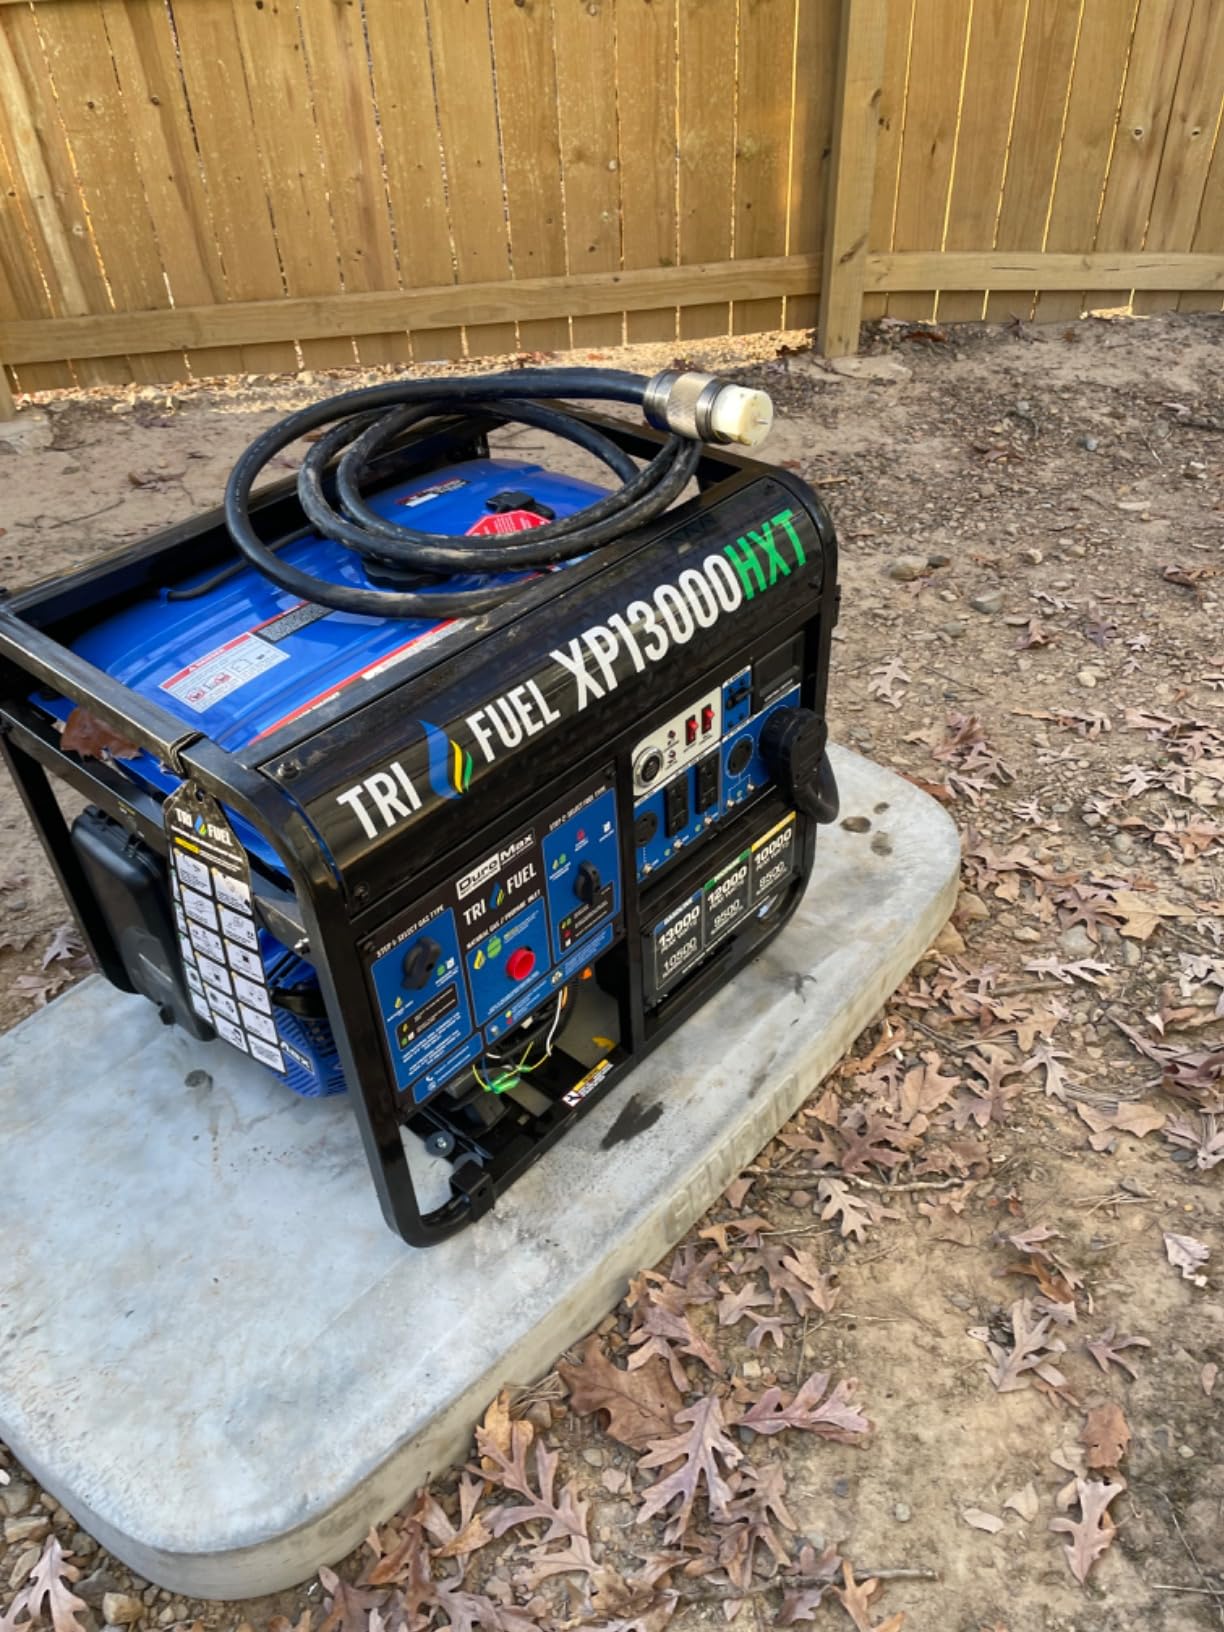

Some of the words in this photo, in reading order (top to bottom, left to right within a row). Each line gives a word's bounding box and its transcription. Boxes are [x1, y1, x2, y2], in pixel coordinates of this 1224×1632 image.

[336, 761, 423, 840] TRI
[466, 679, 560, 762] FUEL
[550, 508, 807, 712] XP13000HXT
[207, 823, 233, 847] FUEL
[754, 827, 792, 865] 10000
[463, 898, 487, 926] TRI
[507, 863, 537, 895] FUEL
[707, 865, 747, 903] 12000
[659, 905, 700, 947] 13000
